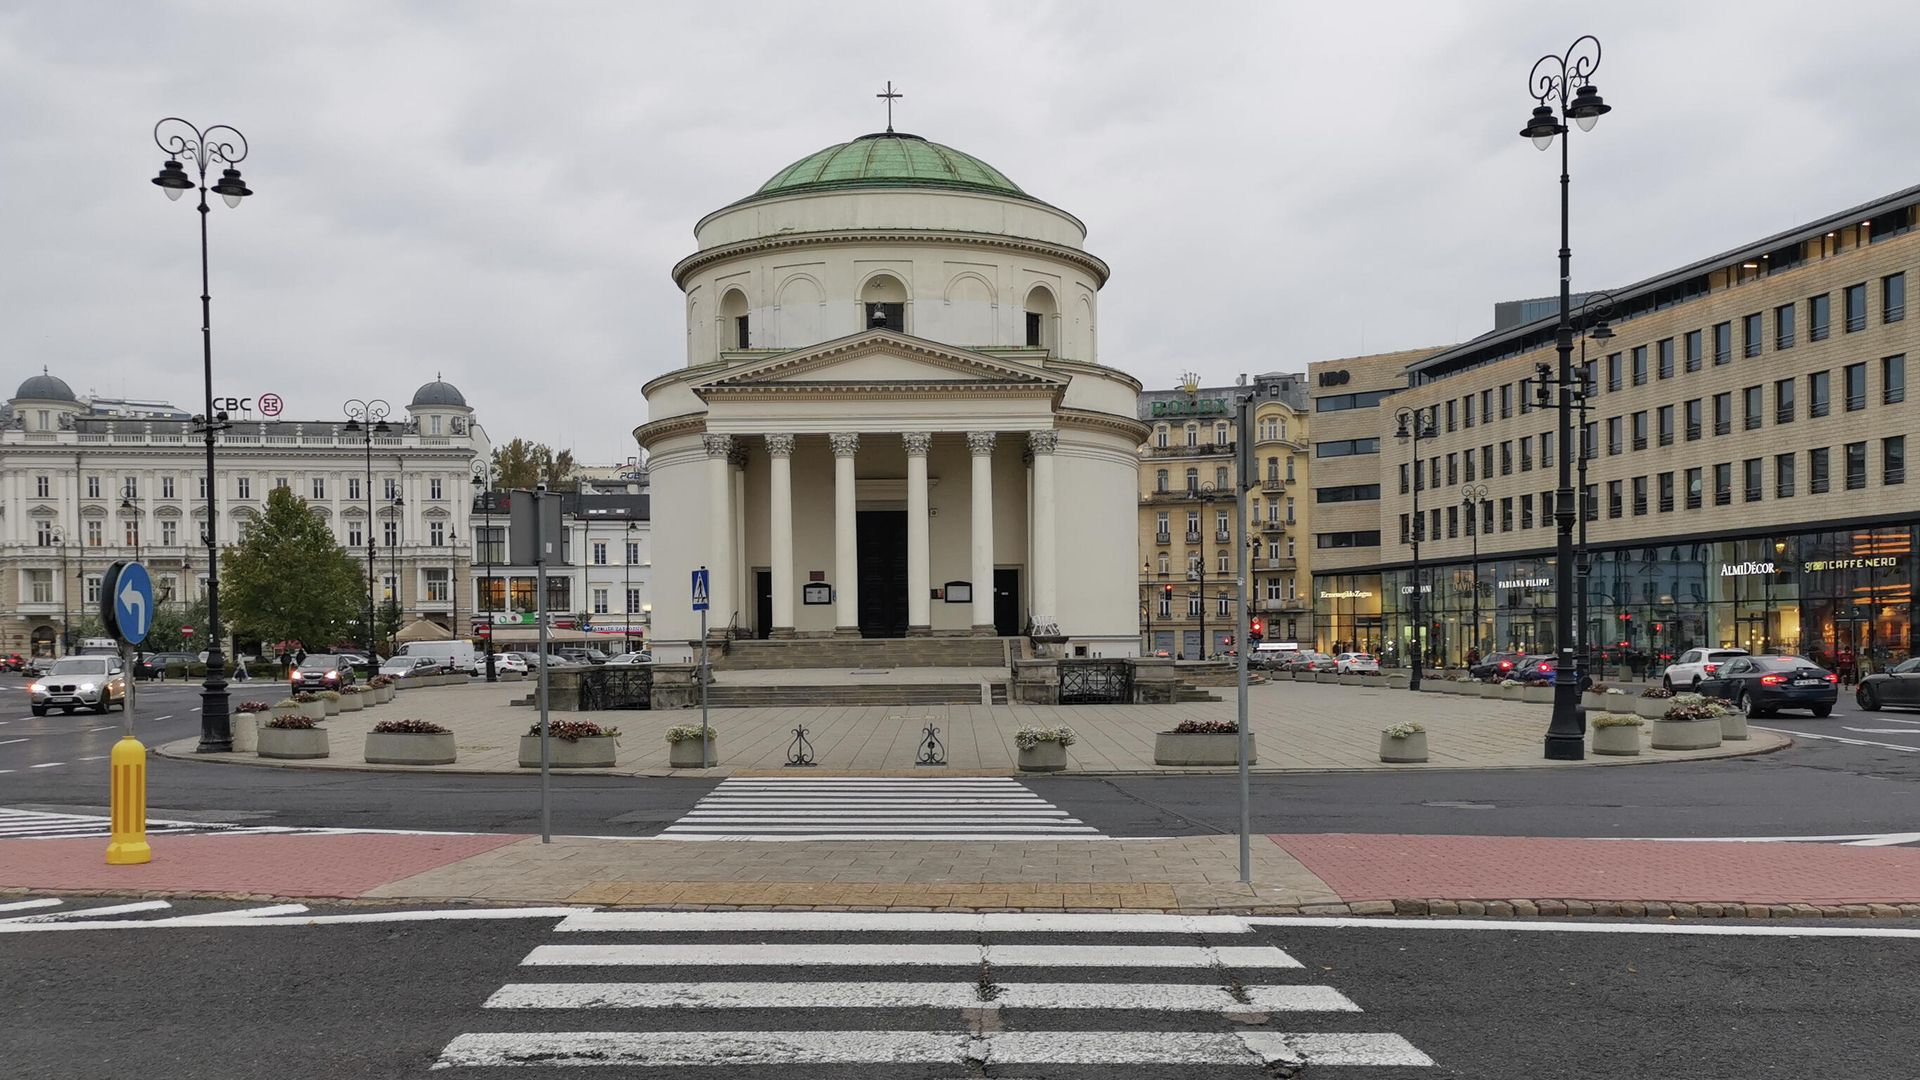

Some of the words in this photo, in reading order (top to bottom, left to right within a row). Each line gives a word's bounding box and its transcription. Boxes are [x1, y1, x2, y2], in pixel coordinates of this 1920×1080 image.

[1319, 369, 1350, 387] HBO
[1151, 398, 1229, 417] ROLEX
[1865, 557, 1896, 567] NERO
[1498, 579, 1525, 589] FABIANA
[1525, 578, 1550, 587] FILIPPI
[1401, 584, 1432, 595] CORIANI
